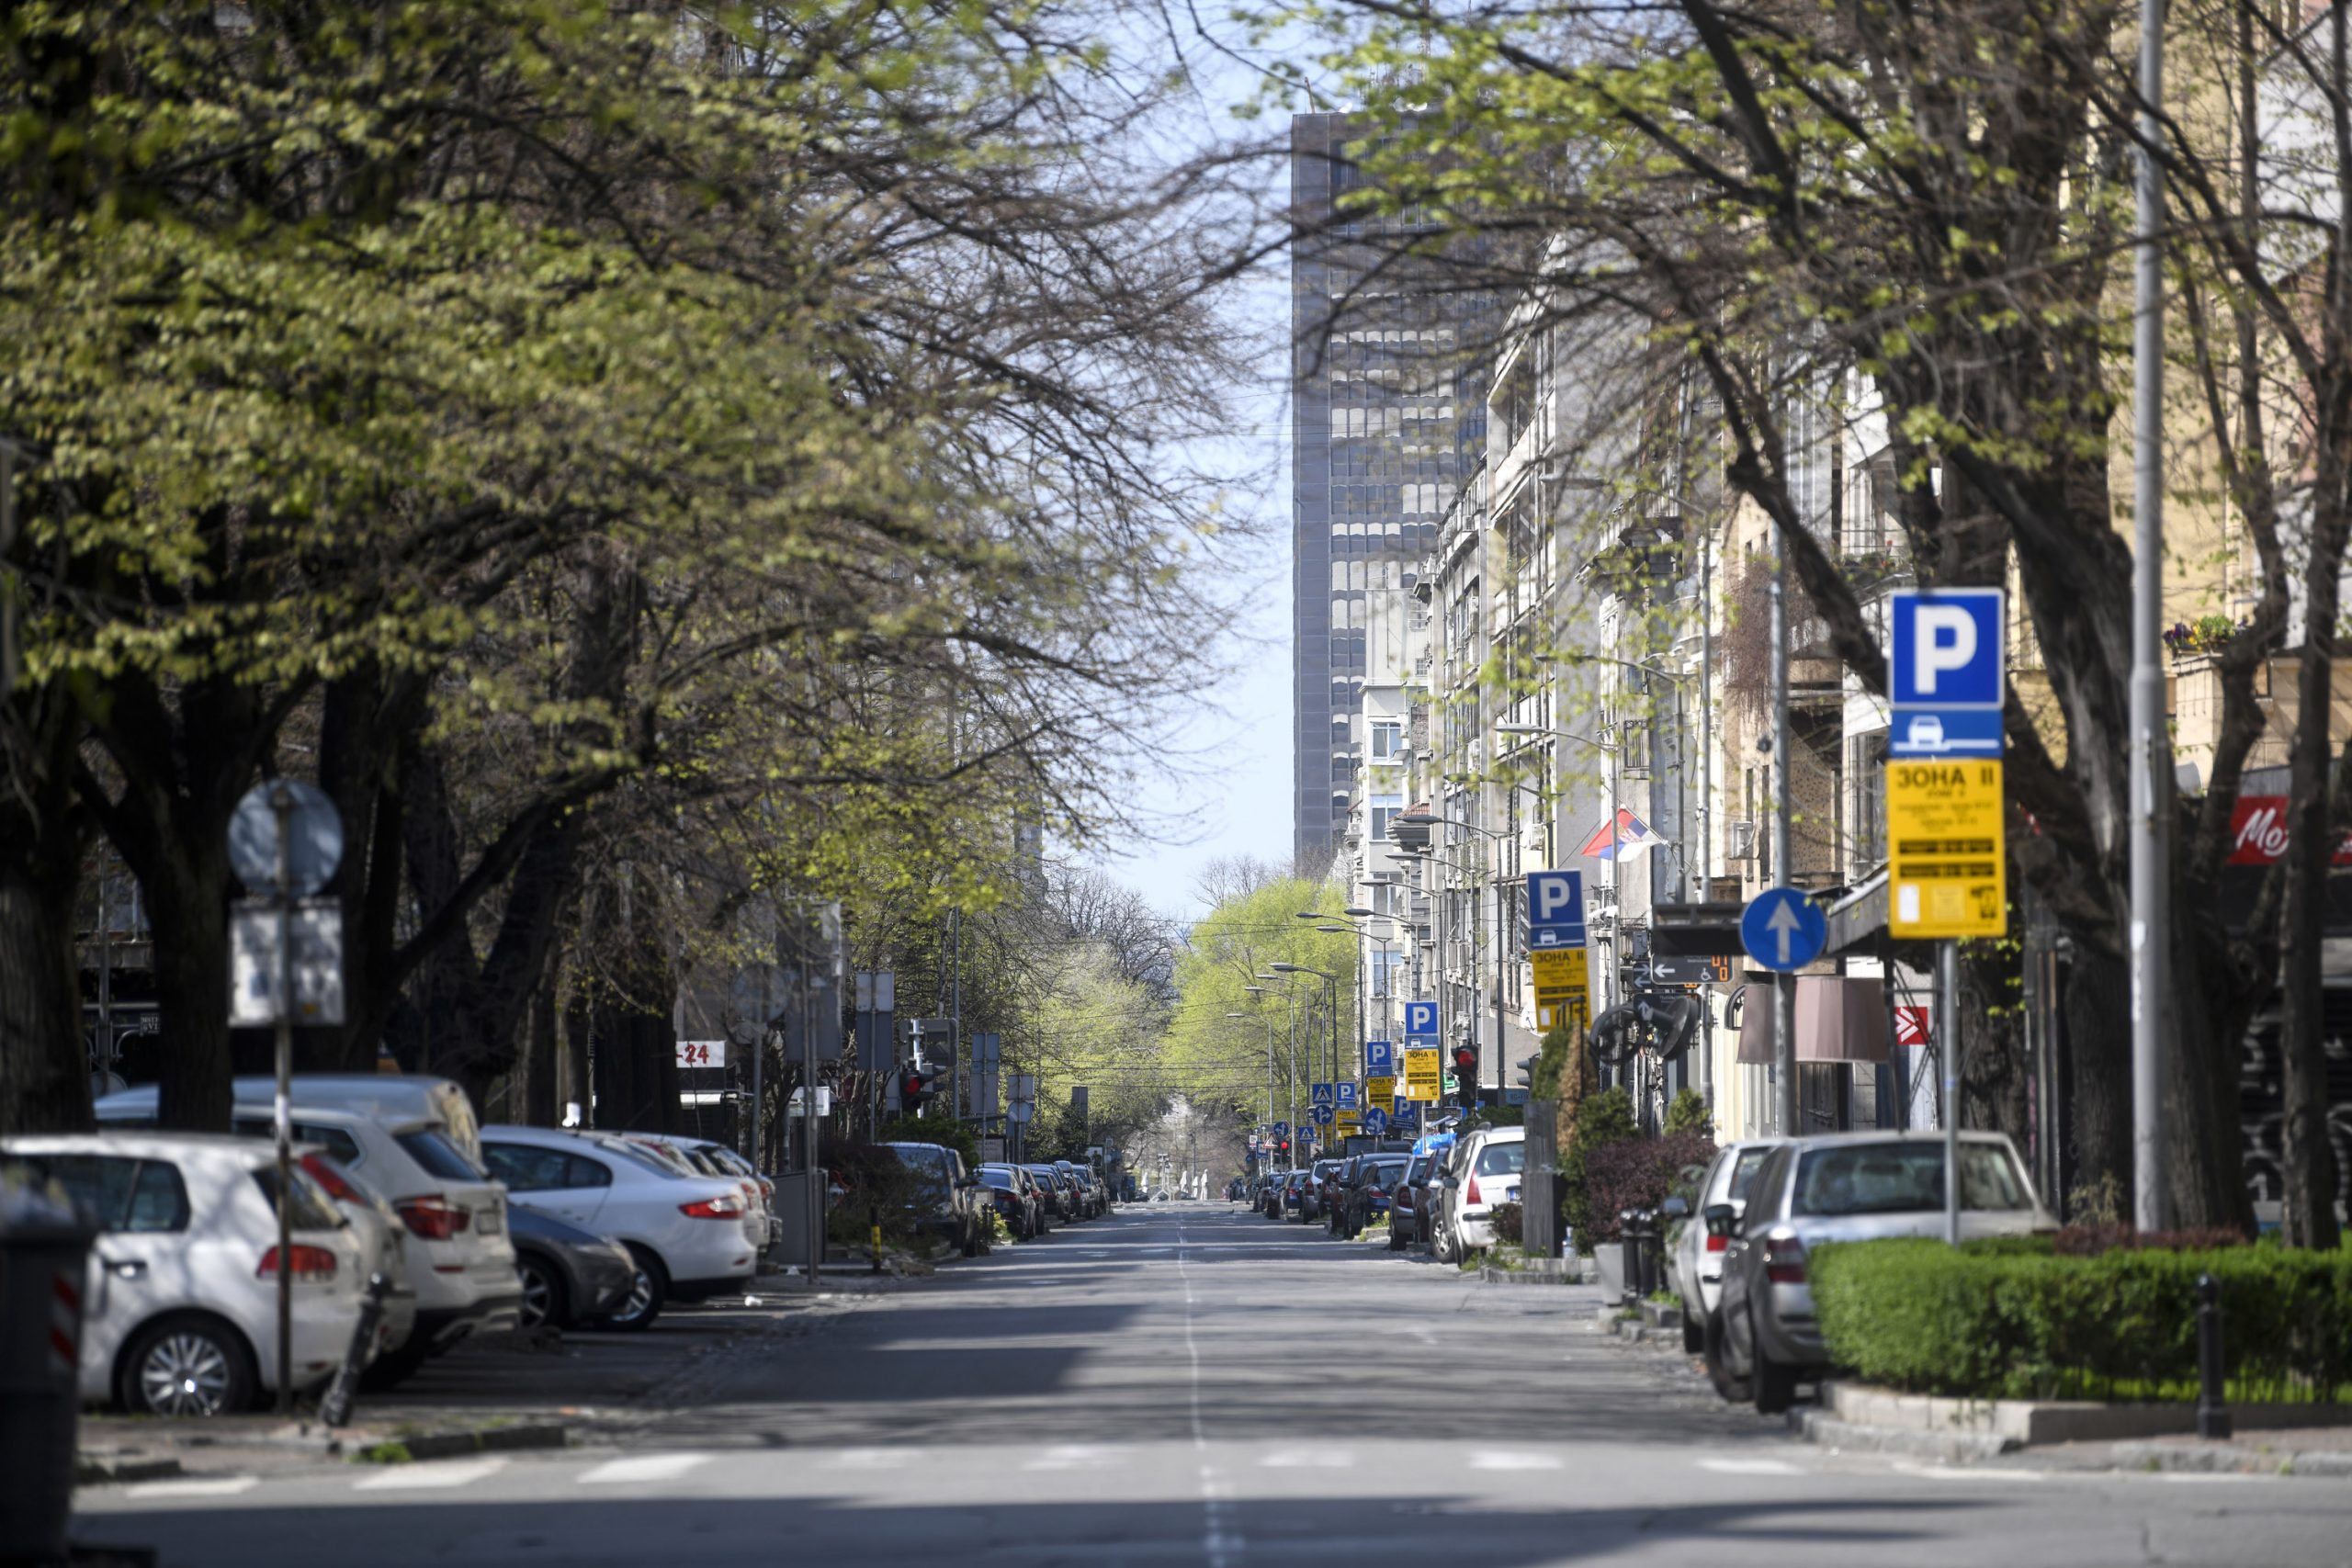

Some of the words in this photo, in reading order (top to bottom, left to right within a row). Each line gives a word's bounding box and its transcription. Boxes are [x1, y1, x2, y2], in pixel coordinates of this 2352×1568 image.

[1914, 605, 1977, 694] P
[1897, 766, 1966, 789] ЗОНА
[1539, 877, 1571, 919] P
[1536, 952, 1570, 963] ЗОНА
[1412, 1006, 1430, 1031] P
[1372, 1044, 1385, 1063] P
[1340, 1085, 1351, 1100] P
[1398, 1100, 1411, 1115] P
